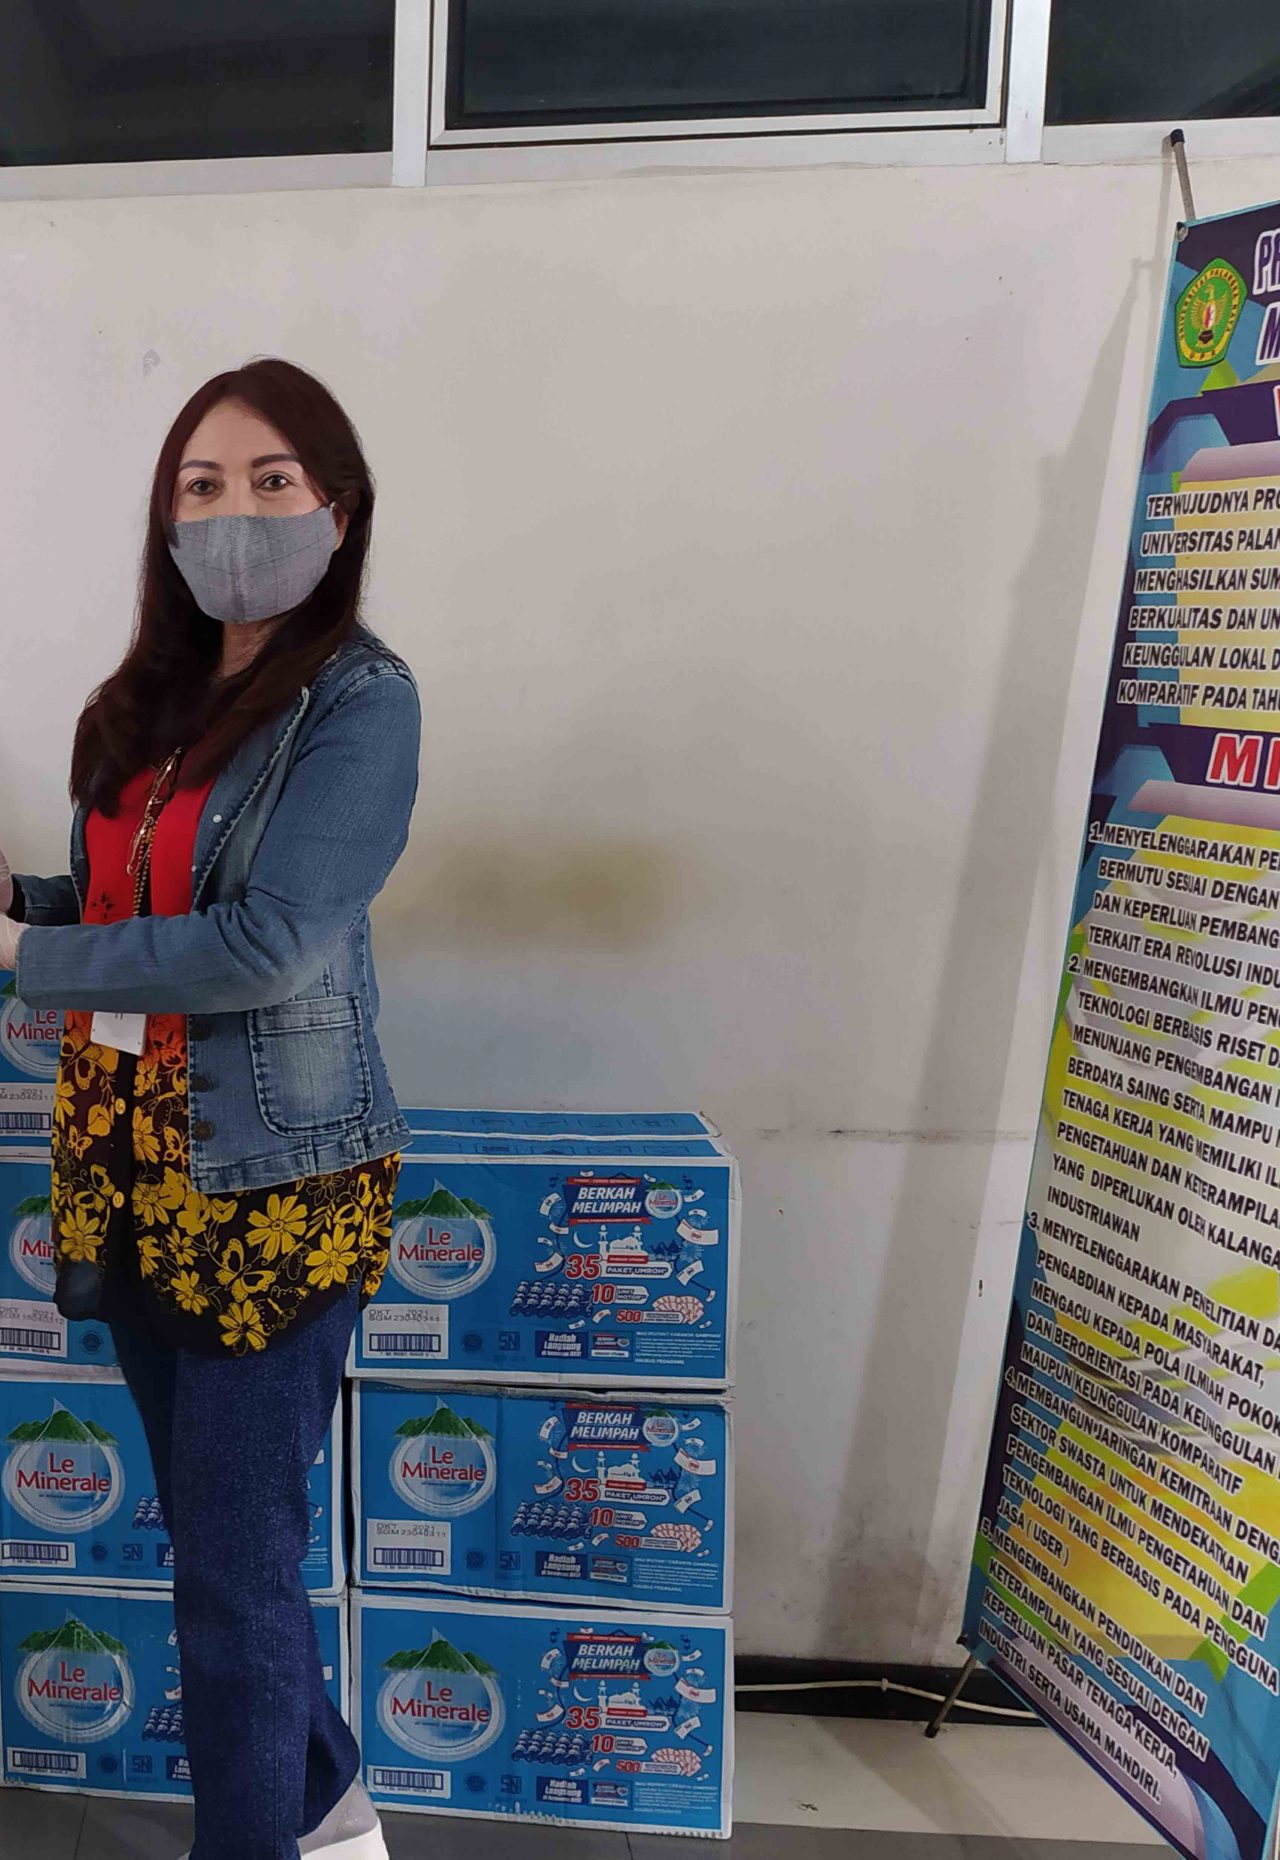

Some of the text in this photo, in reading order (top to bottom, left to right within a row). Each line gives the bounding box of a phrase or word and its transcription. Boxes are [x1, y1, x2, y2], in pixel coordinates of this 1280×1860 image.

[1148, 491, 1249, 517] TERWUJUDNYA
[1142, 530, 1233, 555] UNIVERSITAS
[1135, 568, 1247, 592] MENGHASILKAN
[1130, 607, 1222, 629] BERKUALITAS
[1226, 608, 1257, 630] DAN
[1124, 643, 1267, 670] KEUNGGULAN LOKAL
[1119, 680, 1280, 711] KOMPARATIF PADA TAH
[1103, 824, 1256, 867] MENYELENGGARAKAN
[1098, 859, 1280, 910] BERMUTU SESUAI DENGAN
[1094, 893, 1121, 912] DAN
[1123, 899, 1198, 931] KEPERLUAN
[1089, 925, 1142, 952] TERKAIT
[1143, 937, 1171, 961] ERA
[1175, 946, 1242, 979] REVOLUSI
[1068, 955, 1244, 1018] 2. MENGEMBANGKAN ILMU
[35, 1010, 57, 1025] Le
[1078, 991, 1266, 1063] TEKNOLOGI BERBASIS RISET
[1073, 1025, 1272, 1107] MENUNJANG PENGEMBANGAN
[1067, 1057, 1273, 1145] BERDAYA SAING SERTA MAMPU
[1063, 1089, 1263, 1181] TENAGA KERJA YANG MEMILIKI
[1057, 1121, 1149, 1173] PENGETAHUAN
[1150, 1159, 1182, 1185] DAN
[577, 1186, 636, 1200] BERKAH
[1053, 1153, 1085, 1182] YANG
[1090, 1169, 1175, 1221] DIPERLUKAN
[1178, 1206, 1207, 1238] OLEH
[571, 1201, 642, 1214] MELIMPAH
[1047, 1185, 1141, 1242] INDUSTRIAWAN
[427, 1227, 451, 1246] Le
[398, 1244, 485, 1262] Minerale
[564, 1253, 601, 1279] 35
[1028, 1212, 1260, 1342] 3. MENYELENGGARAKAN PENELITIAN
[592, 1283, 616, 1304] 10
[616, 1310, 642, 1322] 500
[1037, 1249, 1265, 1390] PENGABDIAN KEPADA MASYARAKAT,
[1031, 1280, 1280, 1438] MENGACU KEPADA POLA ILMIAH POKOK
[1026, 1312, 1276, 1475] DAN BERORIENTASI PADA KEUNGGULAN
[577, 1411, 633, 1425] BERKAH
[1022, 1345, 1243, 1496] MAUPUN KEUNGGULAN KOMPARATIF
[570, 1425, 640, 1440] MELIMPAH
[49, 1453, 75, 1473] Le
[431, 1446, 454, 1464] Le
[1018, 1372, 1096, 1433] MEMBANGUN
[1095, 1423, 1158, 1479] JARINGAN
[1160, 1463, 1233, 1533] KEMITRAAN
[17, 1470, 111, 1493] Minerale
[401, 1461, 486, 1481] Minerale
[564, 1478, 601, 1503] 35
[1011, 1404, 1249, 1584] SEKTOR SWASTA UNTUK MENDEKATKAN
[591, 1506, 615, 1528] 10
[997, 1499, 1063, 1559] JASA USER
[615, 1535, 640, 1548] 500
[1007, 1434, 1267, 1639] PENGEMBANGAN ILMU PENGETAHUAN DAN
[1003, 1465, 1280, 1693] TEKNOLOGI YANG BERBASIS PADA PENGGUNA
[993, 1525, 1207, 1717] MENGEMBANGKAN PENDIDIKAN DAN
[577, 1644, 635, 1657] BERKAH
[987, 1558, 1210, 1762] KETERAMPILAN YANG SESUAI DENGAN
[60, 1661, 86, 1684] Le
[571, 1657, 641, 1671] MELIMPAH
[28, 1679, 121, 1702] Minerale
[426, 1680, 453, 1702] Le
[982, 1587, 1178, 1778] KEPERLUAN PASAR TENAGA KERJA,
[391, 1697, 490, 1723] Minerale
[565, 1706, 602, 1729] 35
[979, 1617, 1162, 1802] INDUSTRI SERTA USAHA MANDIRI.
[592, 1734, 616, 1754] 10
